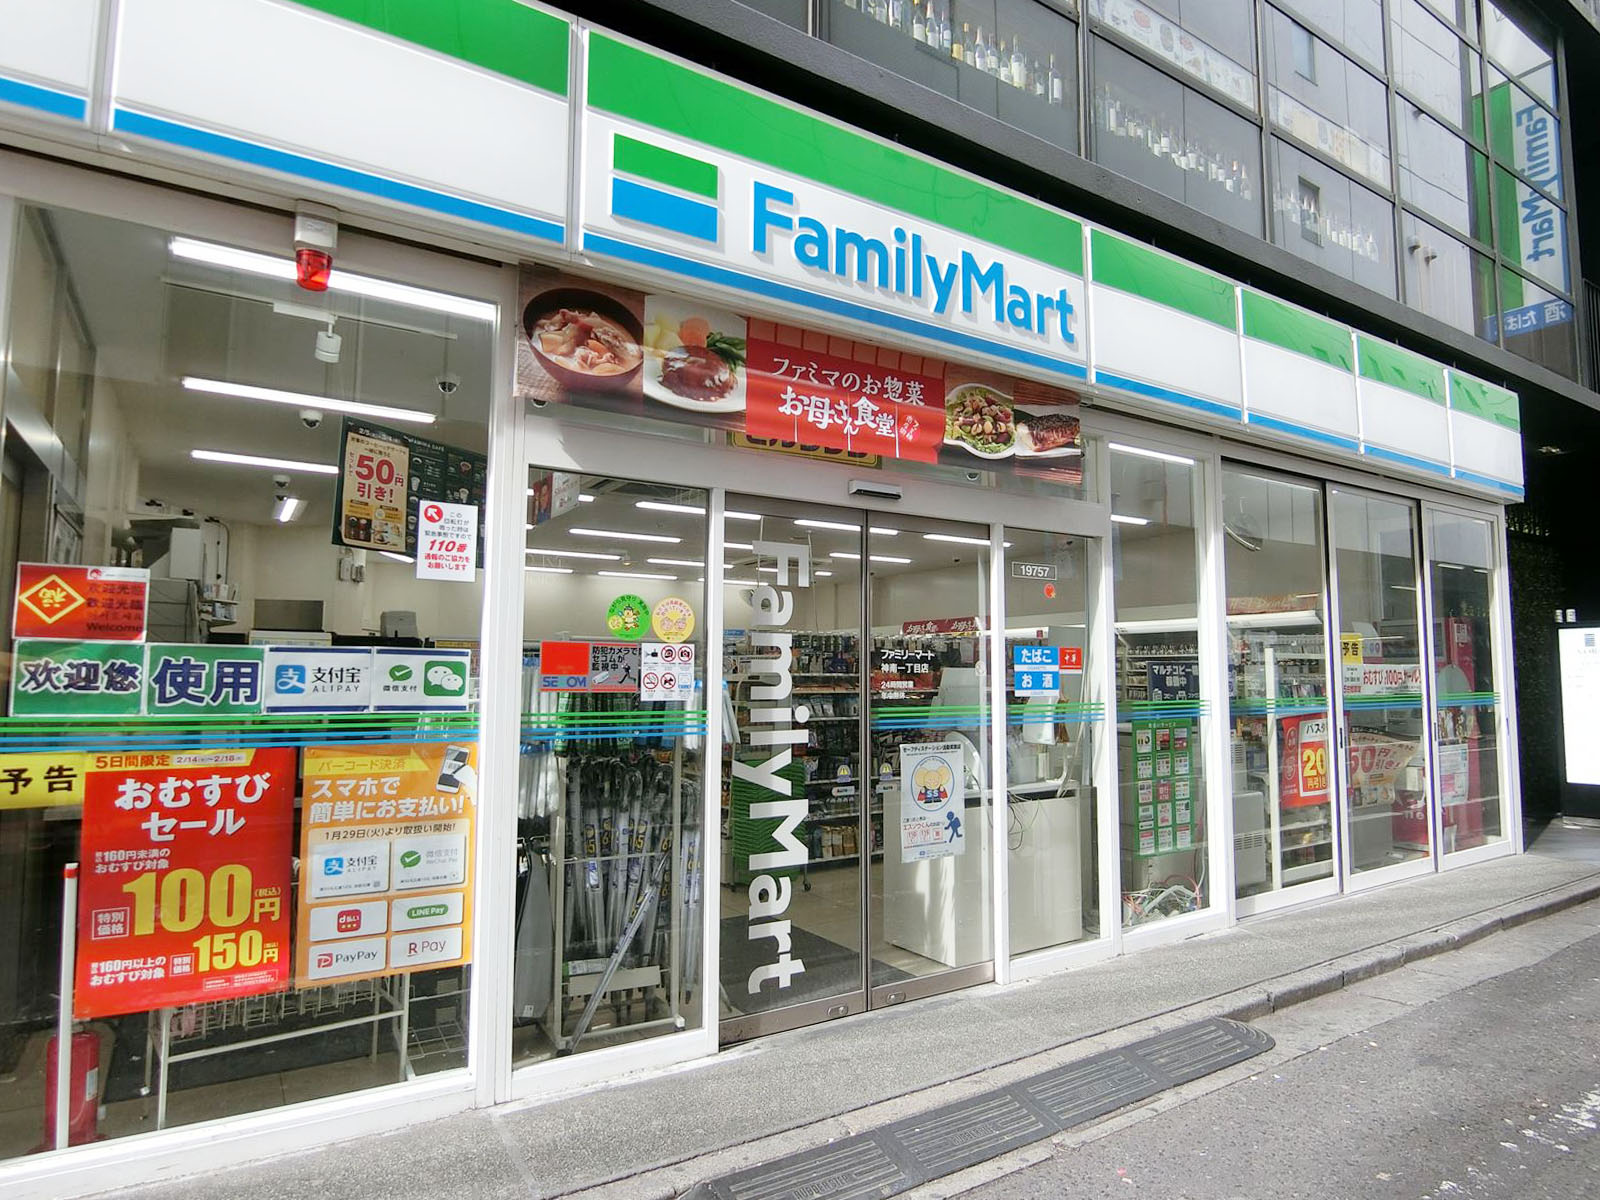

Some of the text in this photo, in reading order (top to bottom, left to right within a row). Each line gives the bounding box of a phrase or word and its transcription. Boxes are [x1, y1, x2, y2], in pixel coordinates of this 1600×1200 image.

[753, 181, 1075, 344] FamilyMart
[771, 357, 925, 407] ファミマのお惣菜
[778, 385, 896, 437] お母さん食堂
[357, 482, 394, 503] 引き!
[429, 539, 467, 552] 110番
[427, 562, 467, 571] お願いします
[1020, 565, 1050, 577] 19757
[86, 622, 143, 632] Welcome
[592, 655, 624, 663] セコムが
[880, 649, 935, 660] ファミリーマート
[1021, 648, 1052, 663] たばこ
[592, 663, 619, 671] 監視中
[19, 658, 141, 693] 欢迎您
[152, 657, 262, 706] 使用
[312, 667, 361, 683] 支付宝
[542, 676, 587, 688] SEOM
[312, 685, 360, 693] ALIPAY
[382, 684, 418, 693] 微信支付
[96, 755, 170, 769] 5日間限定
[319, 758, 406, 772] バーコード決済
[732, 540, 810, 995] FamilyMart
[0, 765, 78, 795] 予告
[115, 771, 271, 810] おむすび
[312, 776, 400, 799] スマホで
[309, 795, 465, 825] 簡単にお支払い!
[142, 808, 246, 842] セール
[95, 860, 170, 874] おむすび対象
[347, 854, 378, 866] 支付宝
[122, 864, 253, 936] 100
[97, 911, 124, 924] 特別
[412, 906, 445, 917] LINE Pay
[97, 923, 124, 936] 価格
[193, 929, 263, 972] 150
[408, 940, 447, 957] R Pay
[335, 950, 378, 964] PayPay
[90, 969, 166, 987] おむすび対象
